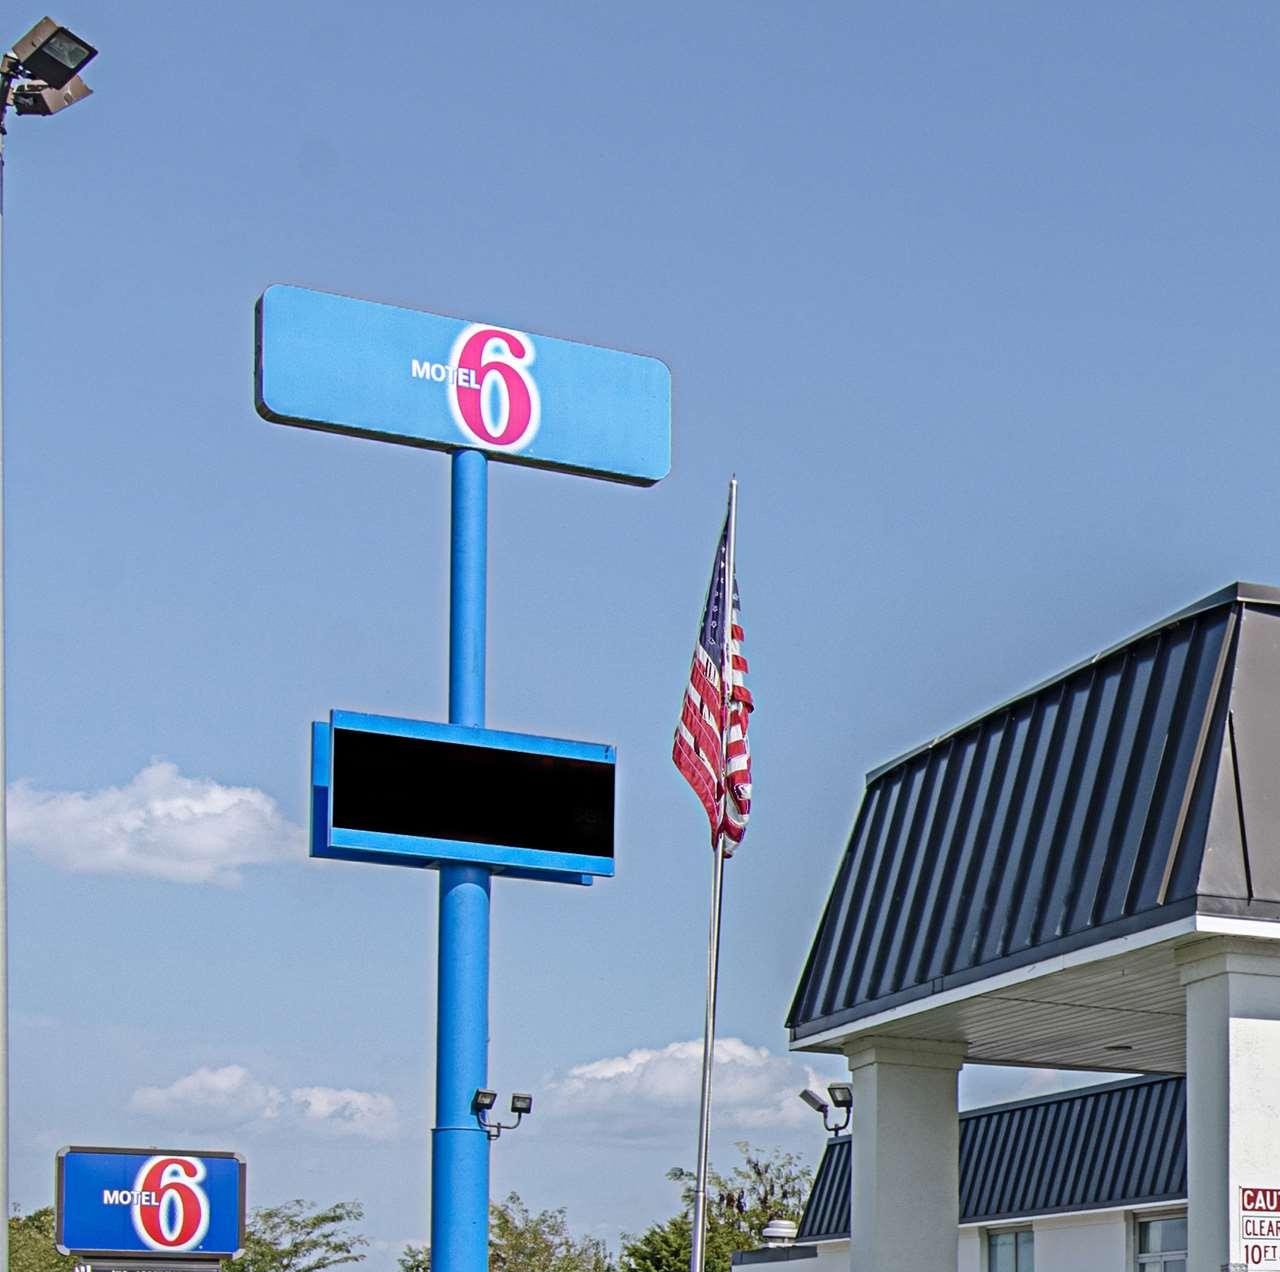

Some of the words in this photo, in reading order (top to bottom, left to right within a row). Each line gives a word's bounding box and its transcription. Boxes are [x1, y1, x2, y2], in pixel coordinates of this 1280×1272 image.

[411, 359, 482, 390] MOTEL
[449, 323, 541, 451] 6
[103, 1189, 160, 1206] MOTEL
[132, 1156, 210, 1251] 6
